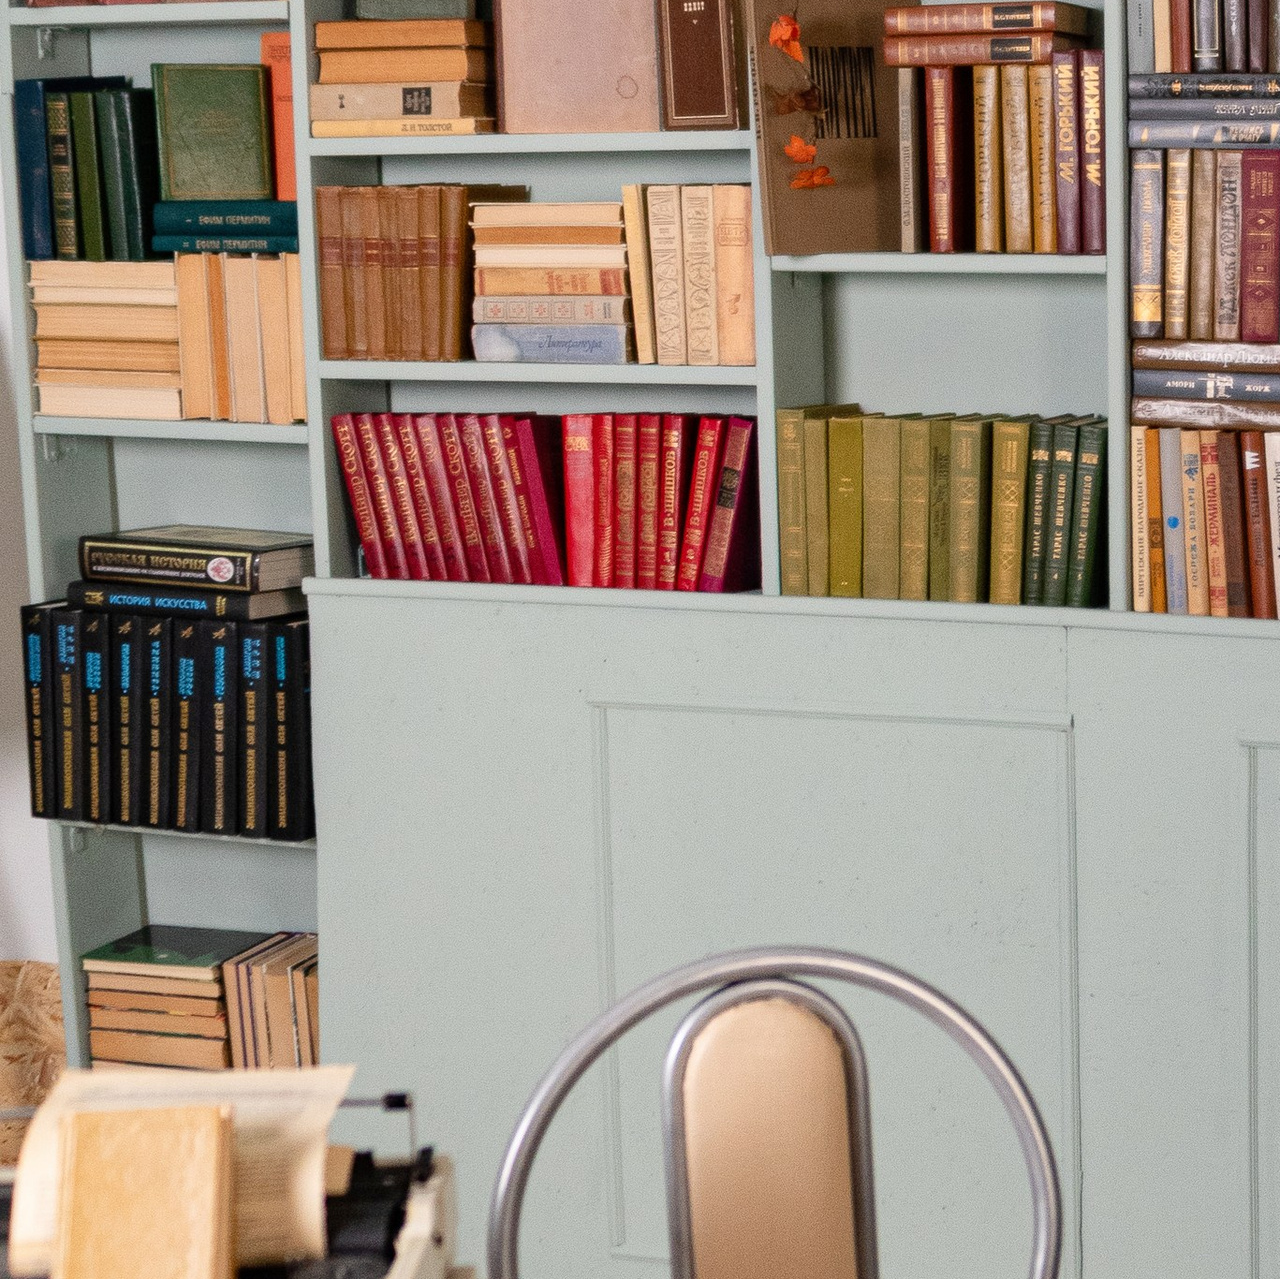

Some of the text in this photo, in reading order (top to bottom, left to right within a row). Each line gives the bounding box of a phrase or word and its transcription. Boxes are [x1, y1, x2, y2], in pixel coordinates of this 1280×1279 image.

[418, 124, 452, 132] ТОЛСТОЙ
[1055, 65, 1074, 183] М. ГОРЬКИЙ
[1081, 66, 1101, 186] М. ГОРЬКИЙ
[1219, 179, 1238, 313] Джек ЛОНДОН
[1033, 473, 1043, 557] ТАРАС ШЕВЧЕНКО
[1053, 473, 1067, 559] ТАРАС ШЕВЧЕНКО
[1077, 475, 1093, 559] ТАРАС ШЕВЧЕНКО
[1136, 479, 1144, 534] НАРОДНЫЕ
[1206, 473, 1219, 547] ЖЕРМИНАЛЬ
[109, 594, 208, 610] ИСТОРИЯ ИСКУССТВА
[150, 555, 207, 570] ИСТОРИЯ
[1137, 535, 1145, 597] КИРГИЗСКИЕ
